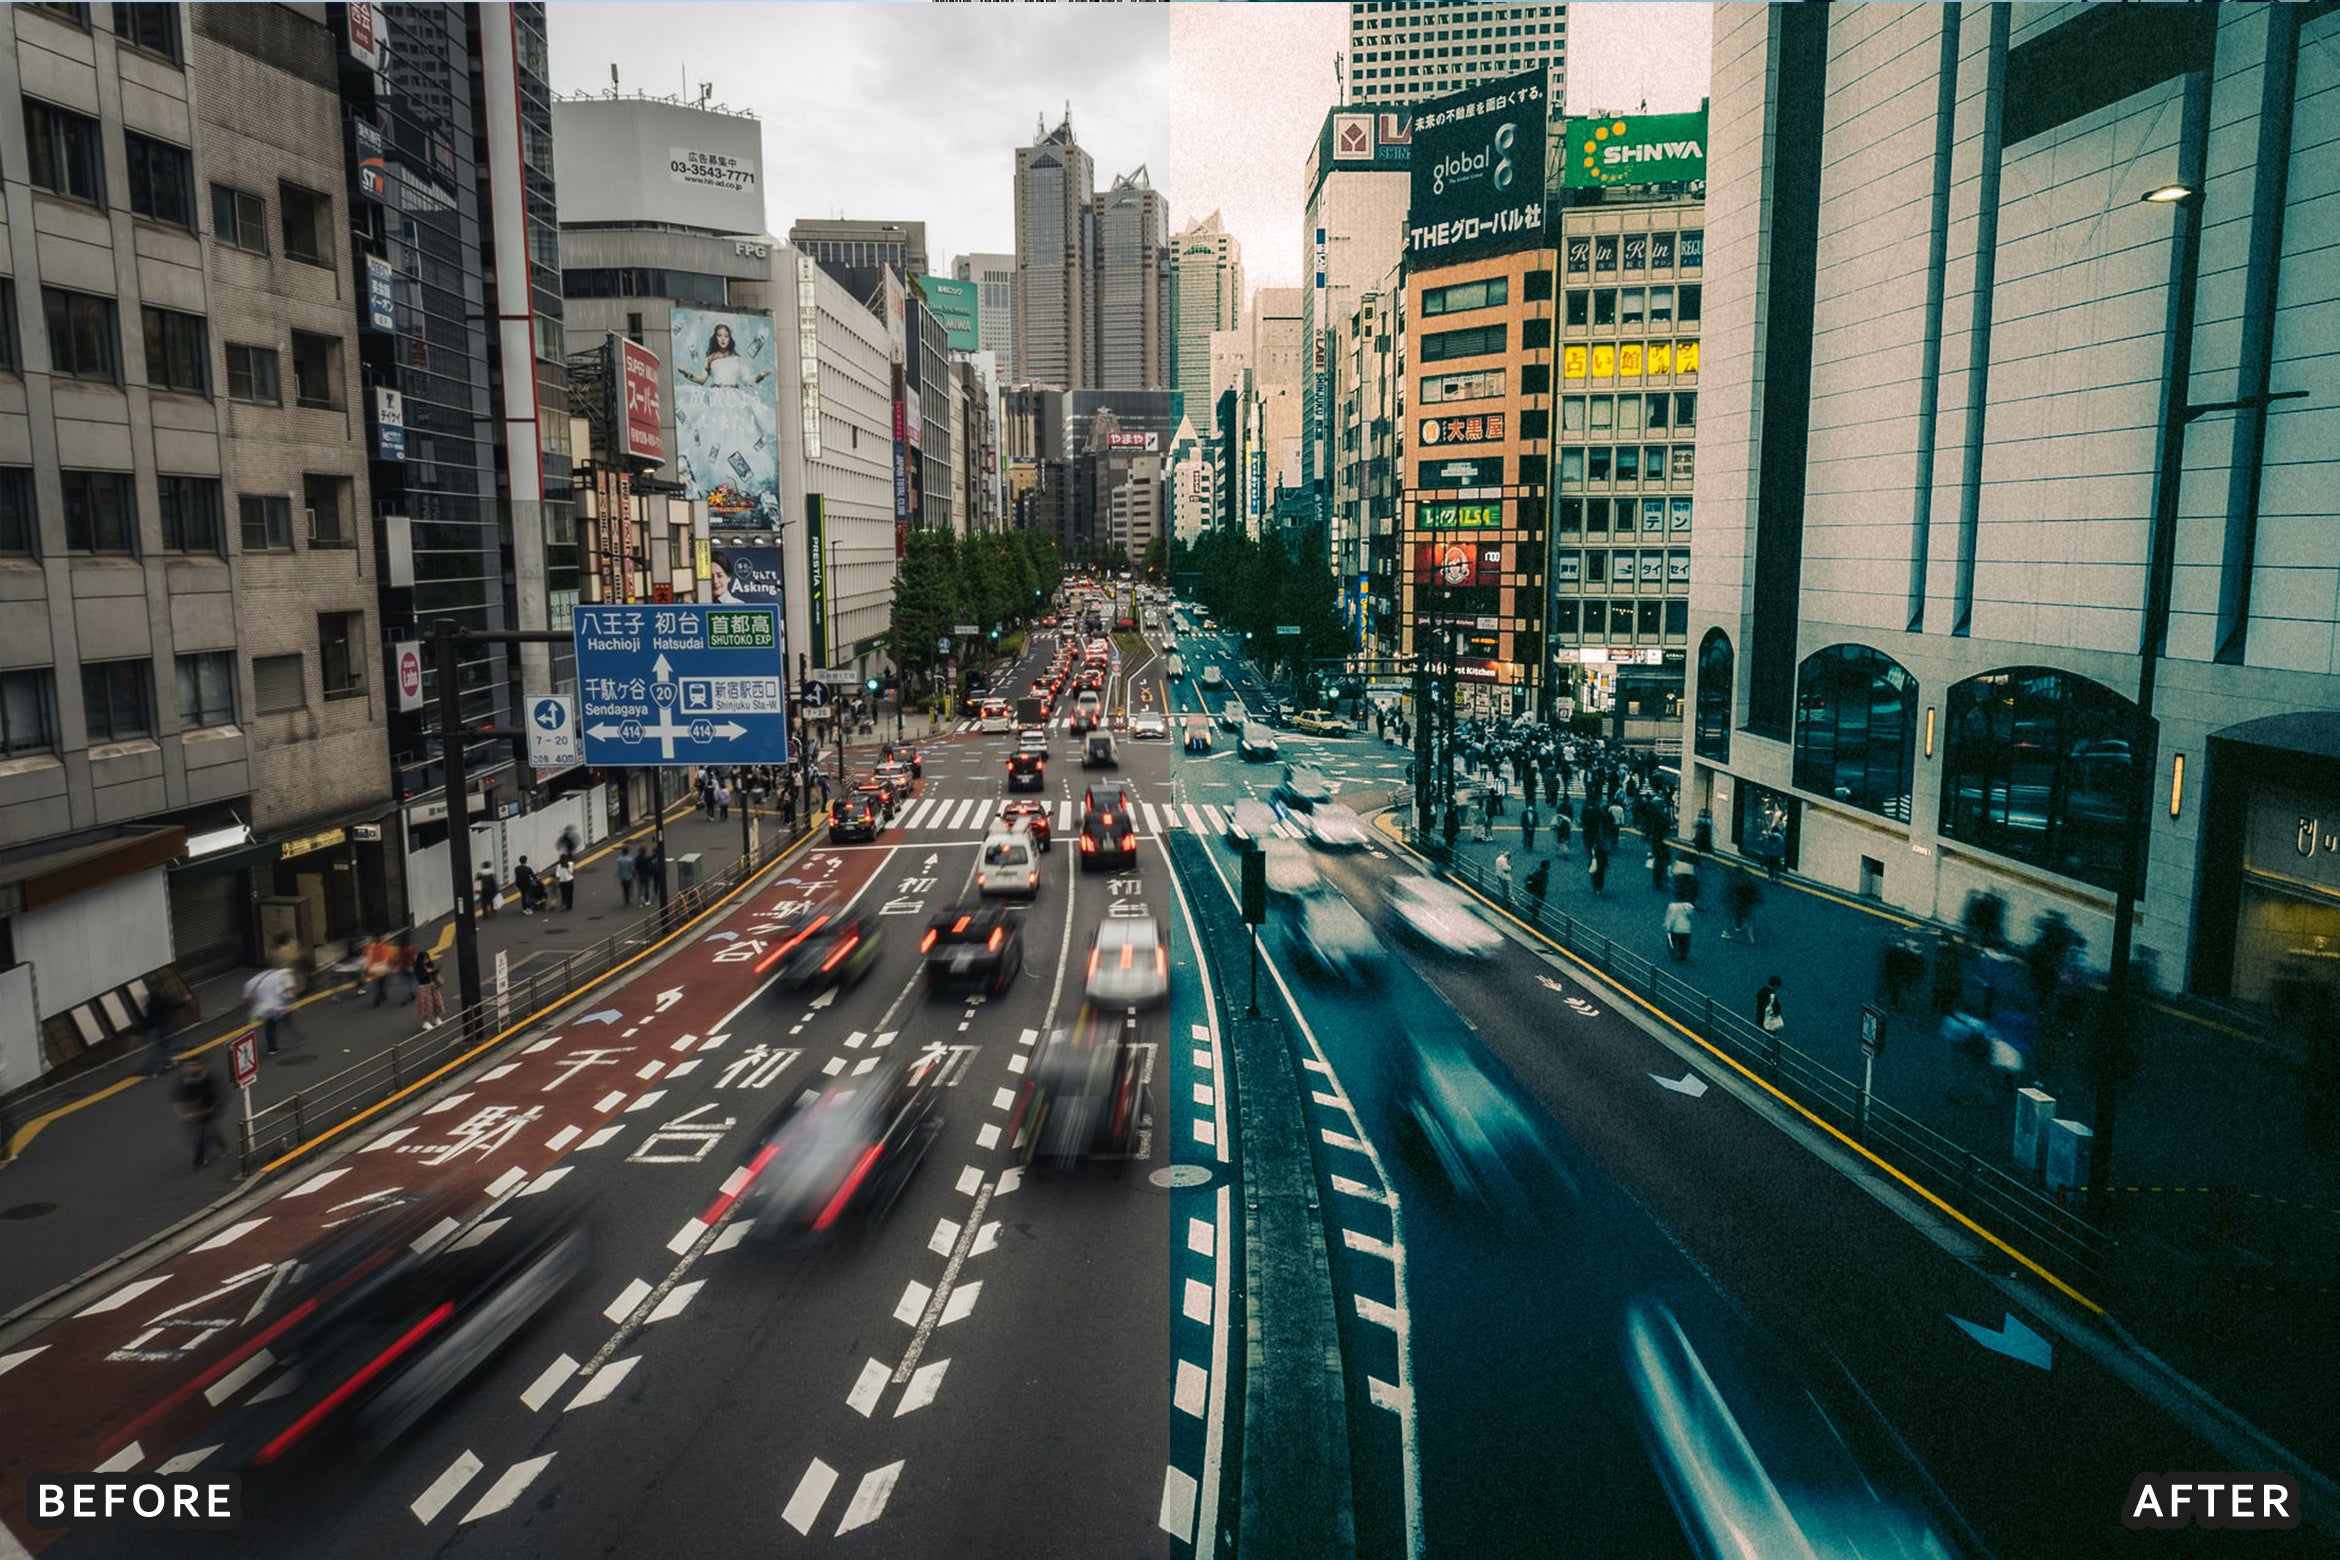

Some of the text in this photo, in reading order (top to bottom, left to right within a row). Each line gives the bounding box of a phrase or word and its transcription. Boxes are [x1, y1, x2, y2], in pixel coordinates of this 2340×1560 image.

[1415, 86, 1543, 132] 未来の不動産を面白くする。
[688, 151, 737, 167] 広告募集中
[670, 160, 755, 184] 03-3543-7771
[1434, 145, 1489, 195] global
[685, 176, 743, 191] www.hit-ad.co.jp
[1411, 203, 1541, 250] THEグローバル社
[735, 242, 767, 258] FPG
[946, 319, 972, 333] MIWA
[1316, 338, 1325, 416] LABI SHINJUKU
[1448, 416, 1503, 441] 大黒屋
[1110, 433, 1144, 445] やまや
[731, 578, 781, 596] Asking!
[581, 612, 700, 635] 八王子 初台
[711, 615, 770, 634] 首都高
[587, 637, 704, 653] Hachioji Hatsudai
[710, 634, 772, 647] SHUTOKO EXP
[656, 686, 670, 700] 20
[714, 681, 777, 699] 新宿駅西口
[585, 703, 648, 718] Sendagaya
[716, 700, 750, 711] Shinjuku
[622, 726, 641, 738] 414
[692, 726, 711, 738] 414
[879, 876, 938, 916] 初台
[1106, 878, 1150, 918] 初台
[625, 1043, 805, 1163] 初台
